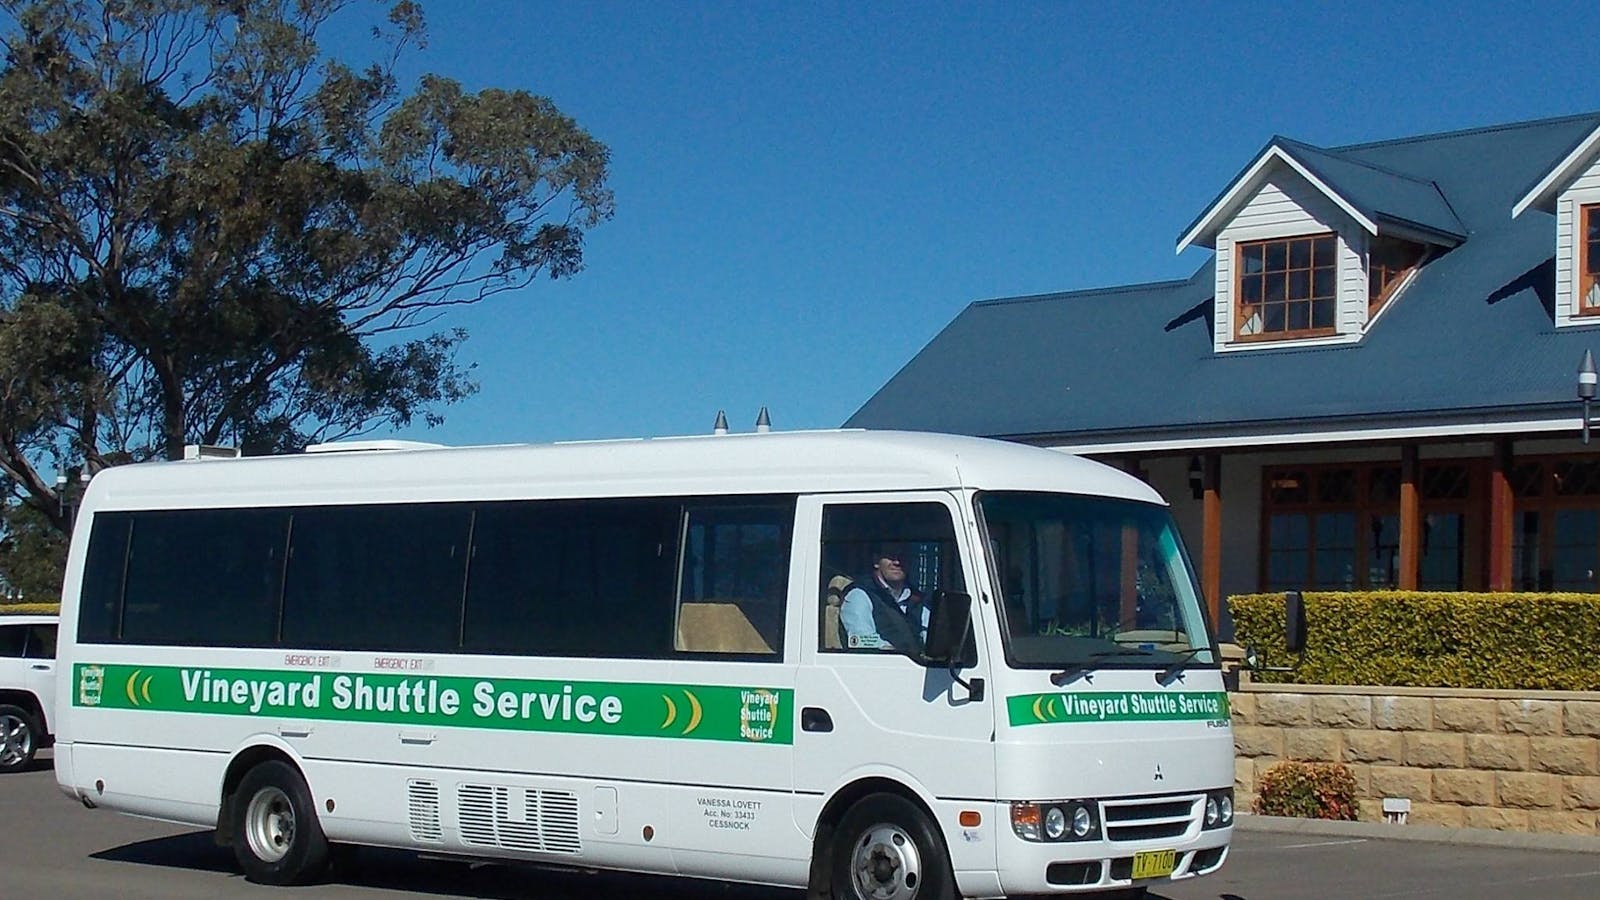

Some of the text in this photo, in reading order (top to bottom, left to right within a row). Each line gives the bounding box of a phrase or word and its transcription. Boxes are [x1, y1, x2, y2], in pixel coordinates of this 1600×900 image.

[374, 657, 423, 670] EMERGENCY EXIT
[181, 668, 623, 724] Vineyard Shuttle Service
[741, 690, 779, 707] Vineyard
[1061, 693, 1218, 720] Vineyard Shuttle Service
[741, 707, 772, 721] Shuttle
[741, 725, 773, 739] Service
[697, 798, 761, 809] VANESSA LOVETT
[708, 819, 750, 830] CESSNOCK
